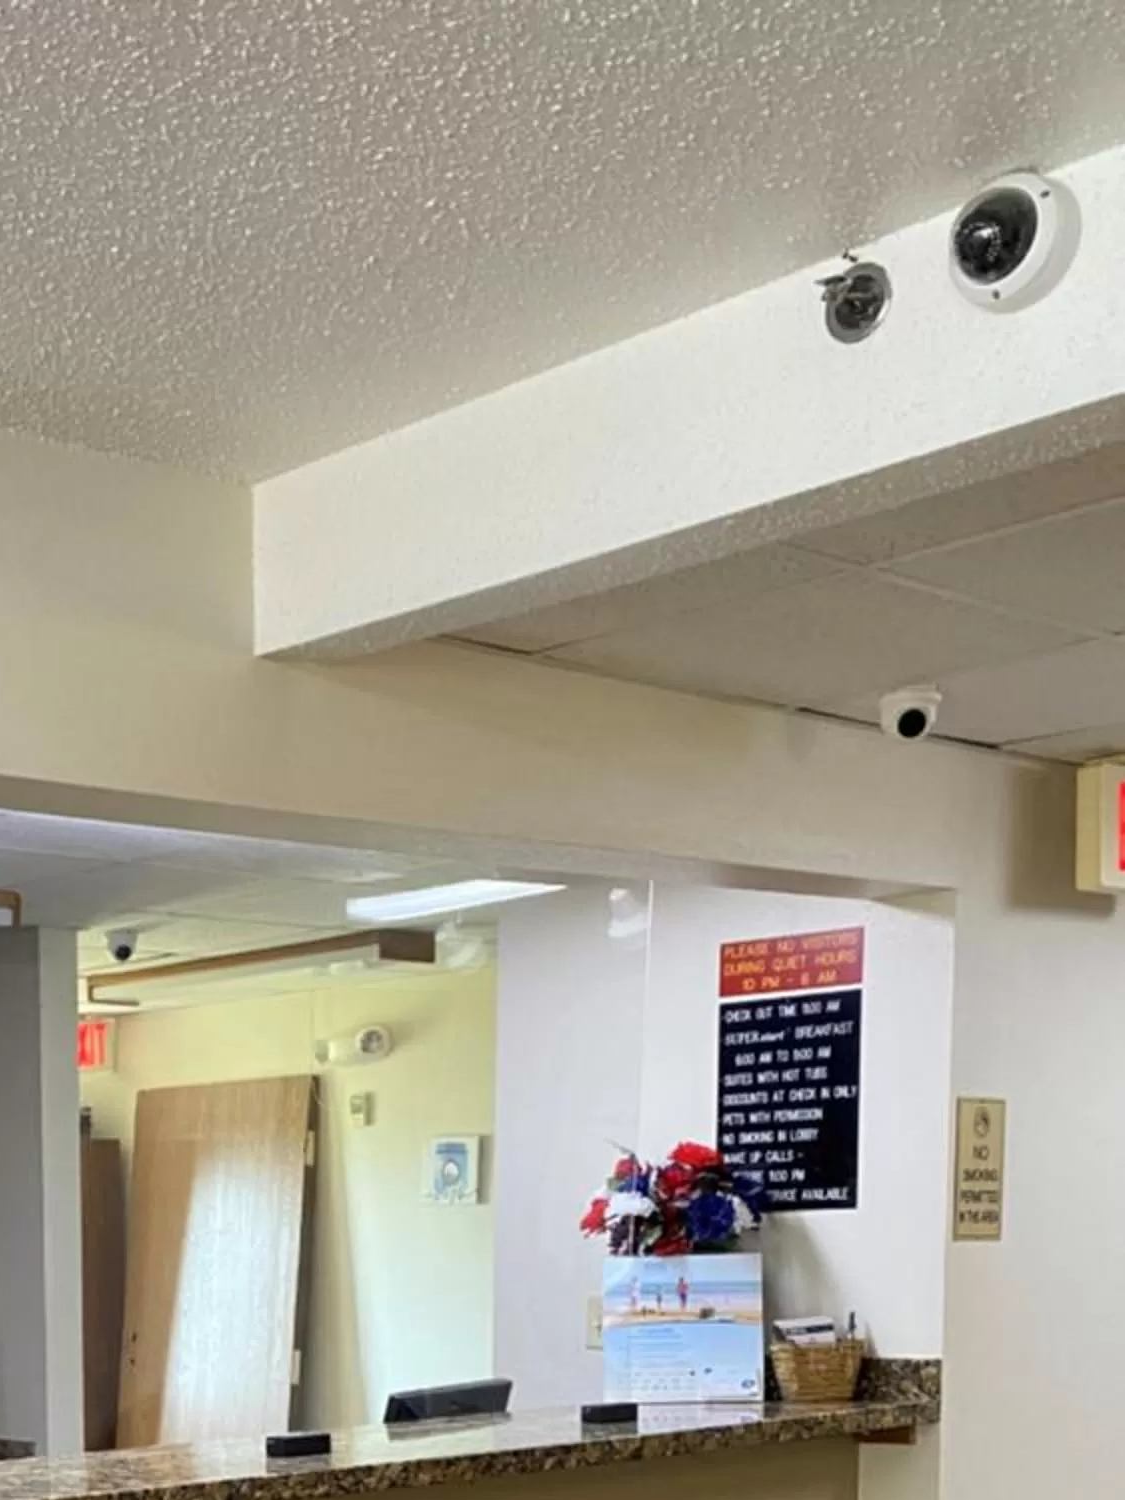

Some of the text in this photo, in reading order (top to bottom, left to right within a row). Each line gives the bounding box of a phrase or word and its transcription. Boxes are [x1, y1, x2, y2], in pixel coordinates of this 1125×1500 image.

[723, 932, 858, 959] PLEASE NO VISITORS
[723, 949, 857, 976] DURING QUIET HOURS
[761, 975, 780, 989] PM
[816, 969, 837, 983] AM
[725, 1009, 752, 1024] CHECK
[755, 1005, 773, 1020] OUT
[778, 1003, 796, 1017] TIME
[826, 1000, 841, 1013] AM
[795, 1020, 854, 1040] BREAKFAST
[759, 1051, 773, 1063] AM
[776, 1049, 789, 1062] TO
[817, 1045, 832, 1059] AM
[757, 1070, 779, 1084] WITH
[781, 1068, 800, 1082] HOT
[804, 1066, 827, 1080] TUBS
[773, 1089, 785, 1102] AT
[788, 1087, 816, 1102] CHECK
[820, 1085, 830, 1099] IN
[833, 1084, 857, 1099] ONLY
[723, 1107, 823, 1126] PETS WITH PERMISSION
[723, 1127, 819, 1146] NO SMOKING IN LOBBY
[749, 1150, 762, 1163] UP
[765, 1149, 794, 1163] CALLS
[791, 1168, 806, 1182] PM
[801, 1186, 849, 1201] AVAILABLE
